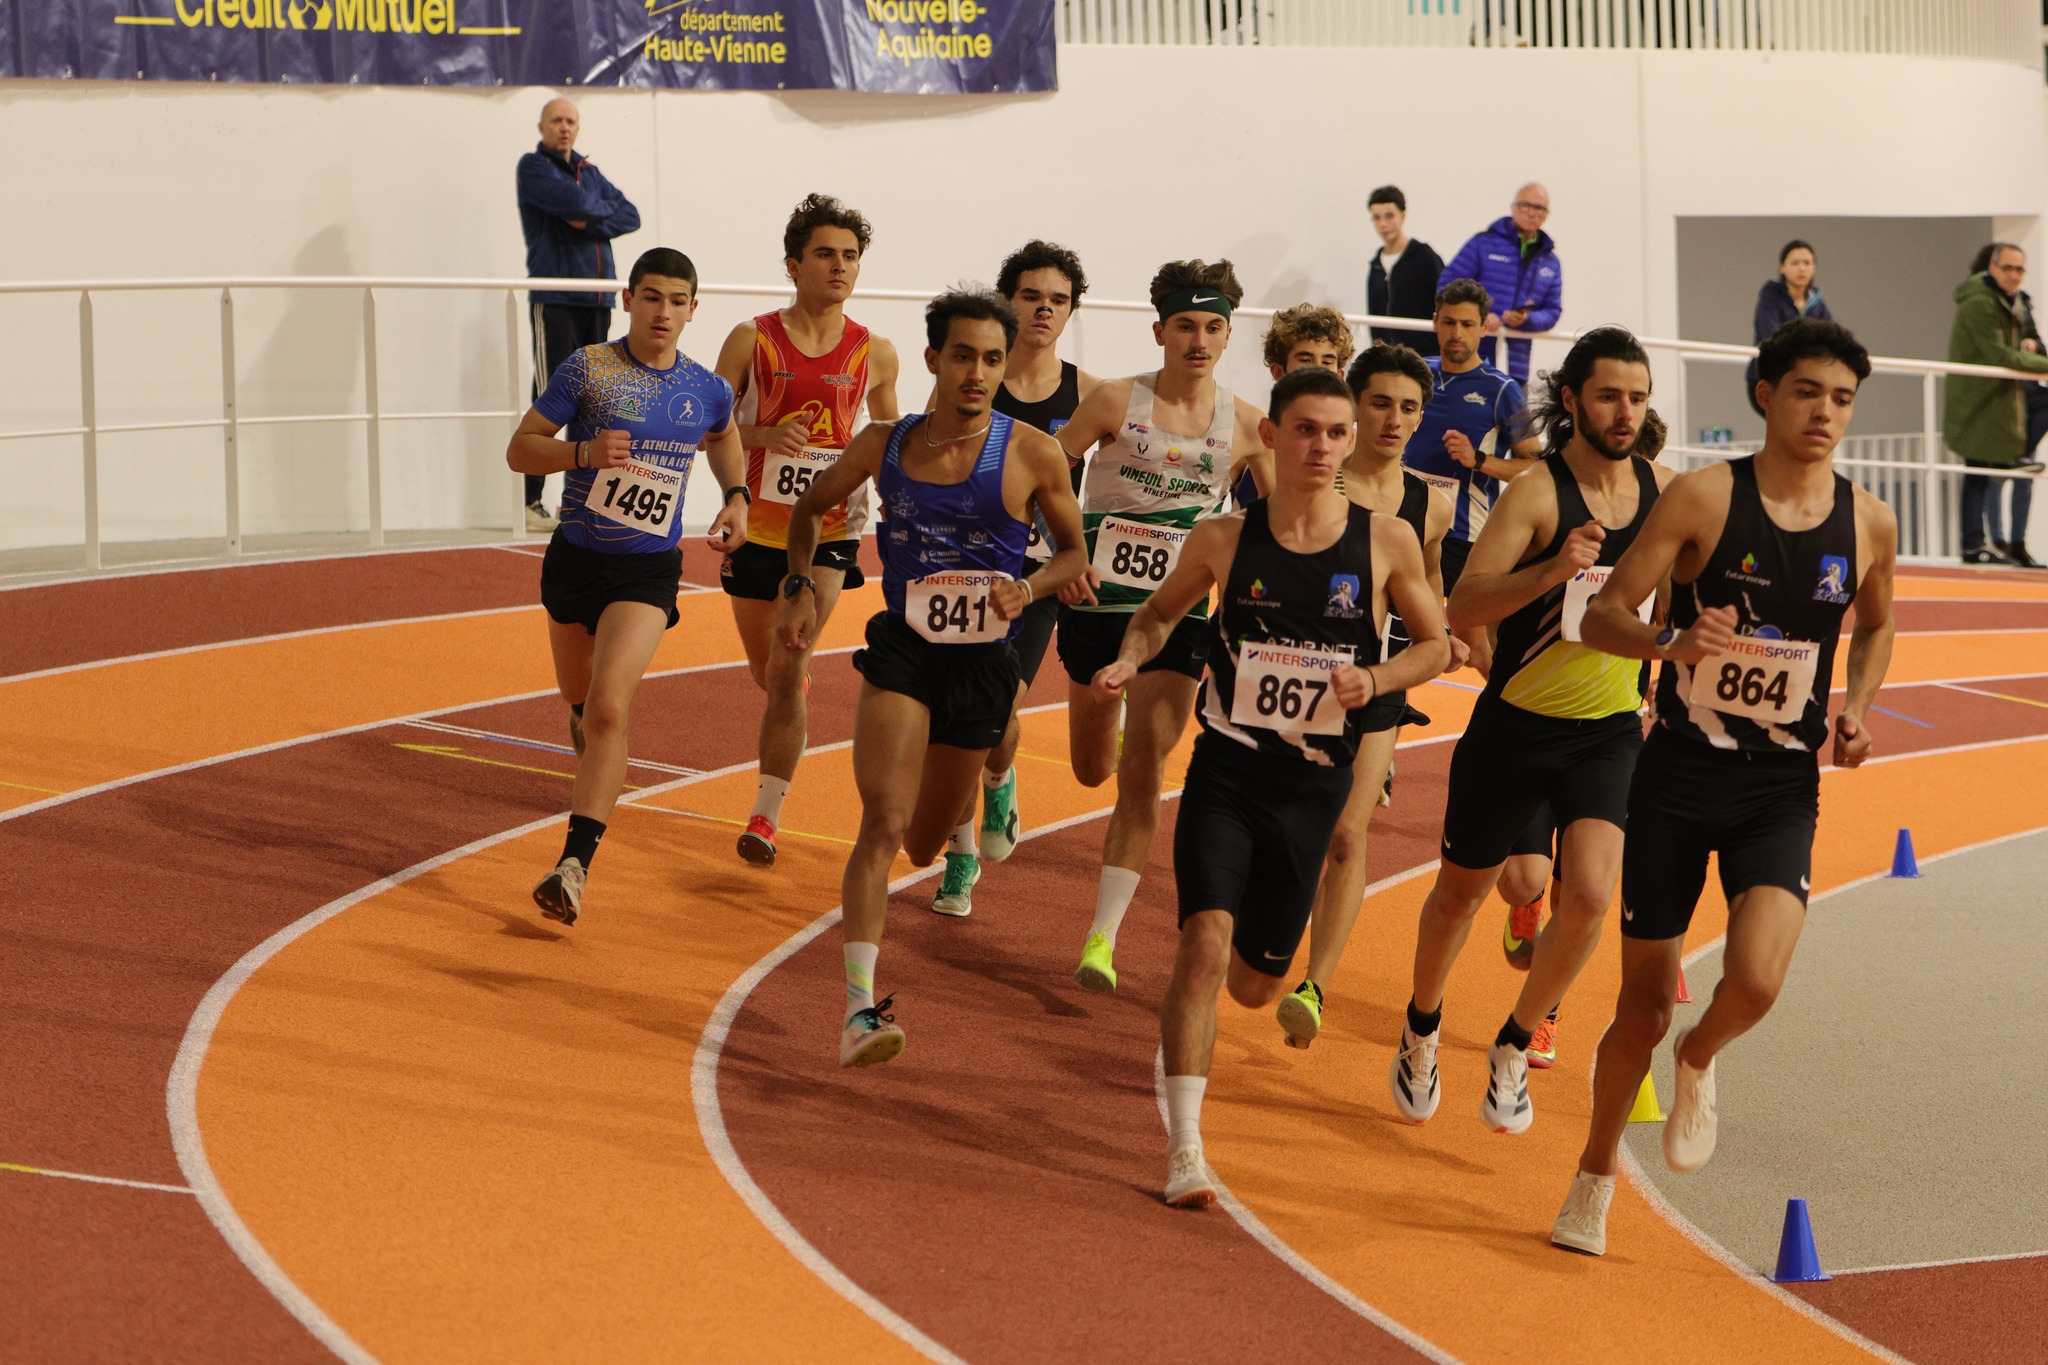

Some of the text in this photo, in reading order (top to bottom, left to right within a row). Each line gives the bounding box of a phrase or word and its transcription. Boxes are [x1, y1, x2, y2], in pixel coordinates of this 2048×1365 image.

[335, 0, 456, 35] Mutuel
[680, 6, 785, 35] département
[865, 0, 987, 24] Nouvelle-
[644, 34, 787, 64] Haute-Vienne
[877, 27, 993, 68] Aquitaine
[1120, 464, 1163, 488] VINEUIL
[1167, 477, 1212, 495] SPORTS
[603, 477, 673, 526] 1495
[1116, 523, 1185, 543] INTERSPORT
[1112, 541, 1169, 582] 858
[926, 575, 1006, 587] INTERSPO
[1724, 569, 1771, 586] futuroscope
[927, 594, 986, 633] 841
[1237, 598, 1281, 608] futuroscope
[1259, 650, 1346, 671] INTERSPOR
[1726, 640, 1811, 661] NTERSPORT
[1256, 674, 1328, 722] 867
[1716, 662, 1789, 711] 864
